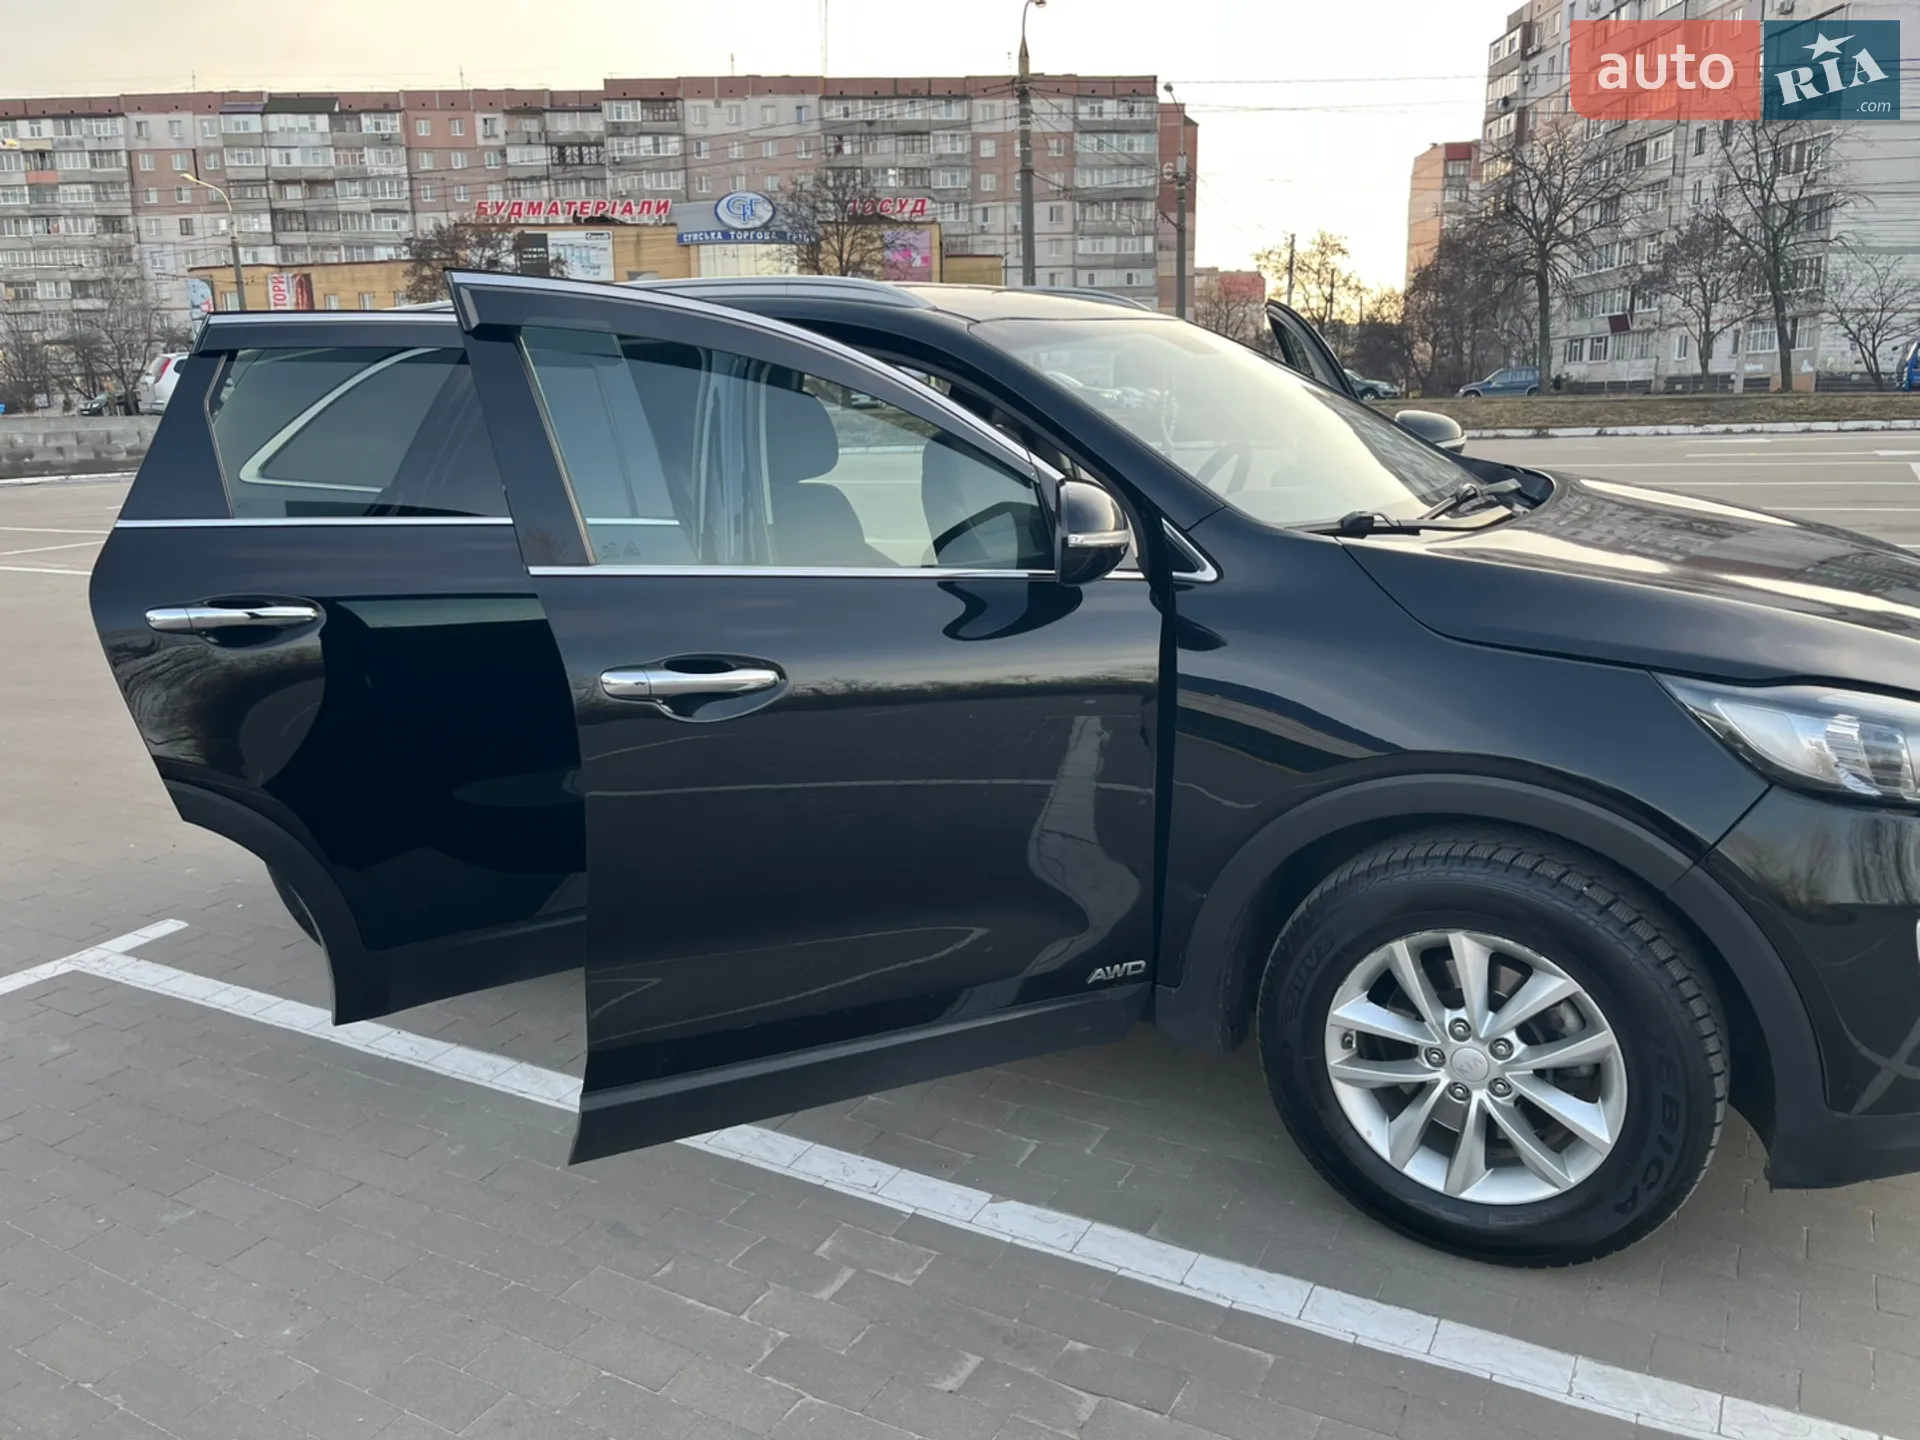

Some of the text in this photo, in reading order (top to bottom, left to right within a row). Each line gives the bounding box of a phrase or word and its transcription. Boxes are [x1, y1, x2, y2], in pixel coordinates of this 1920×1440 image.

[476, 199, 672, 219] БУДМАТЕРІАЛИ
[1086, 959, 1147, 985] AWD
[1455, 1056, 1484, 1076] KIA
